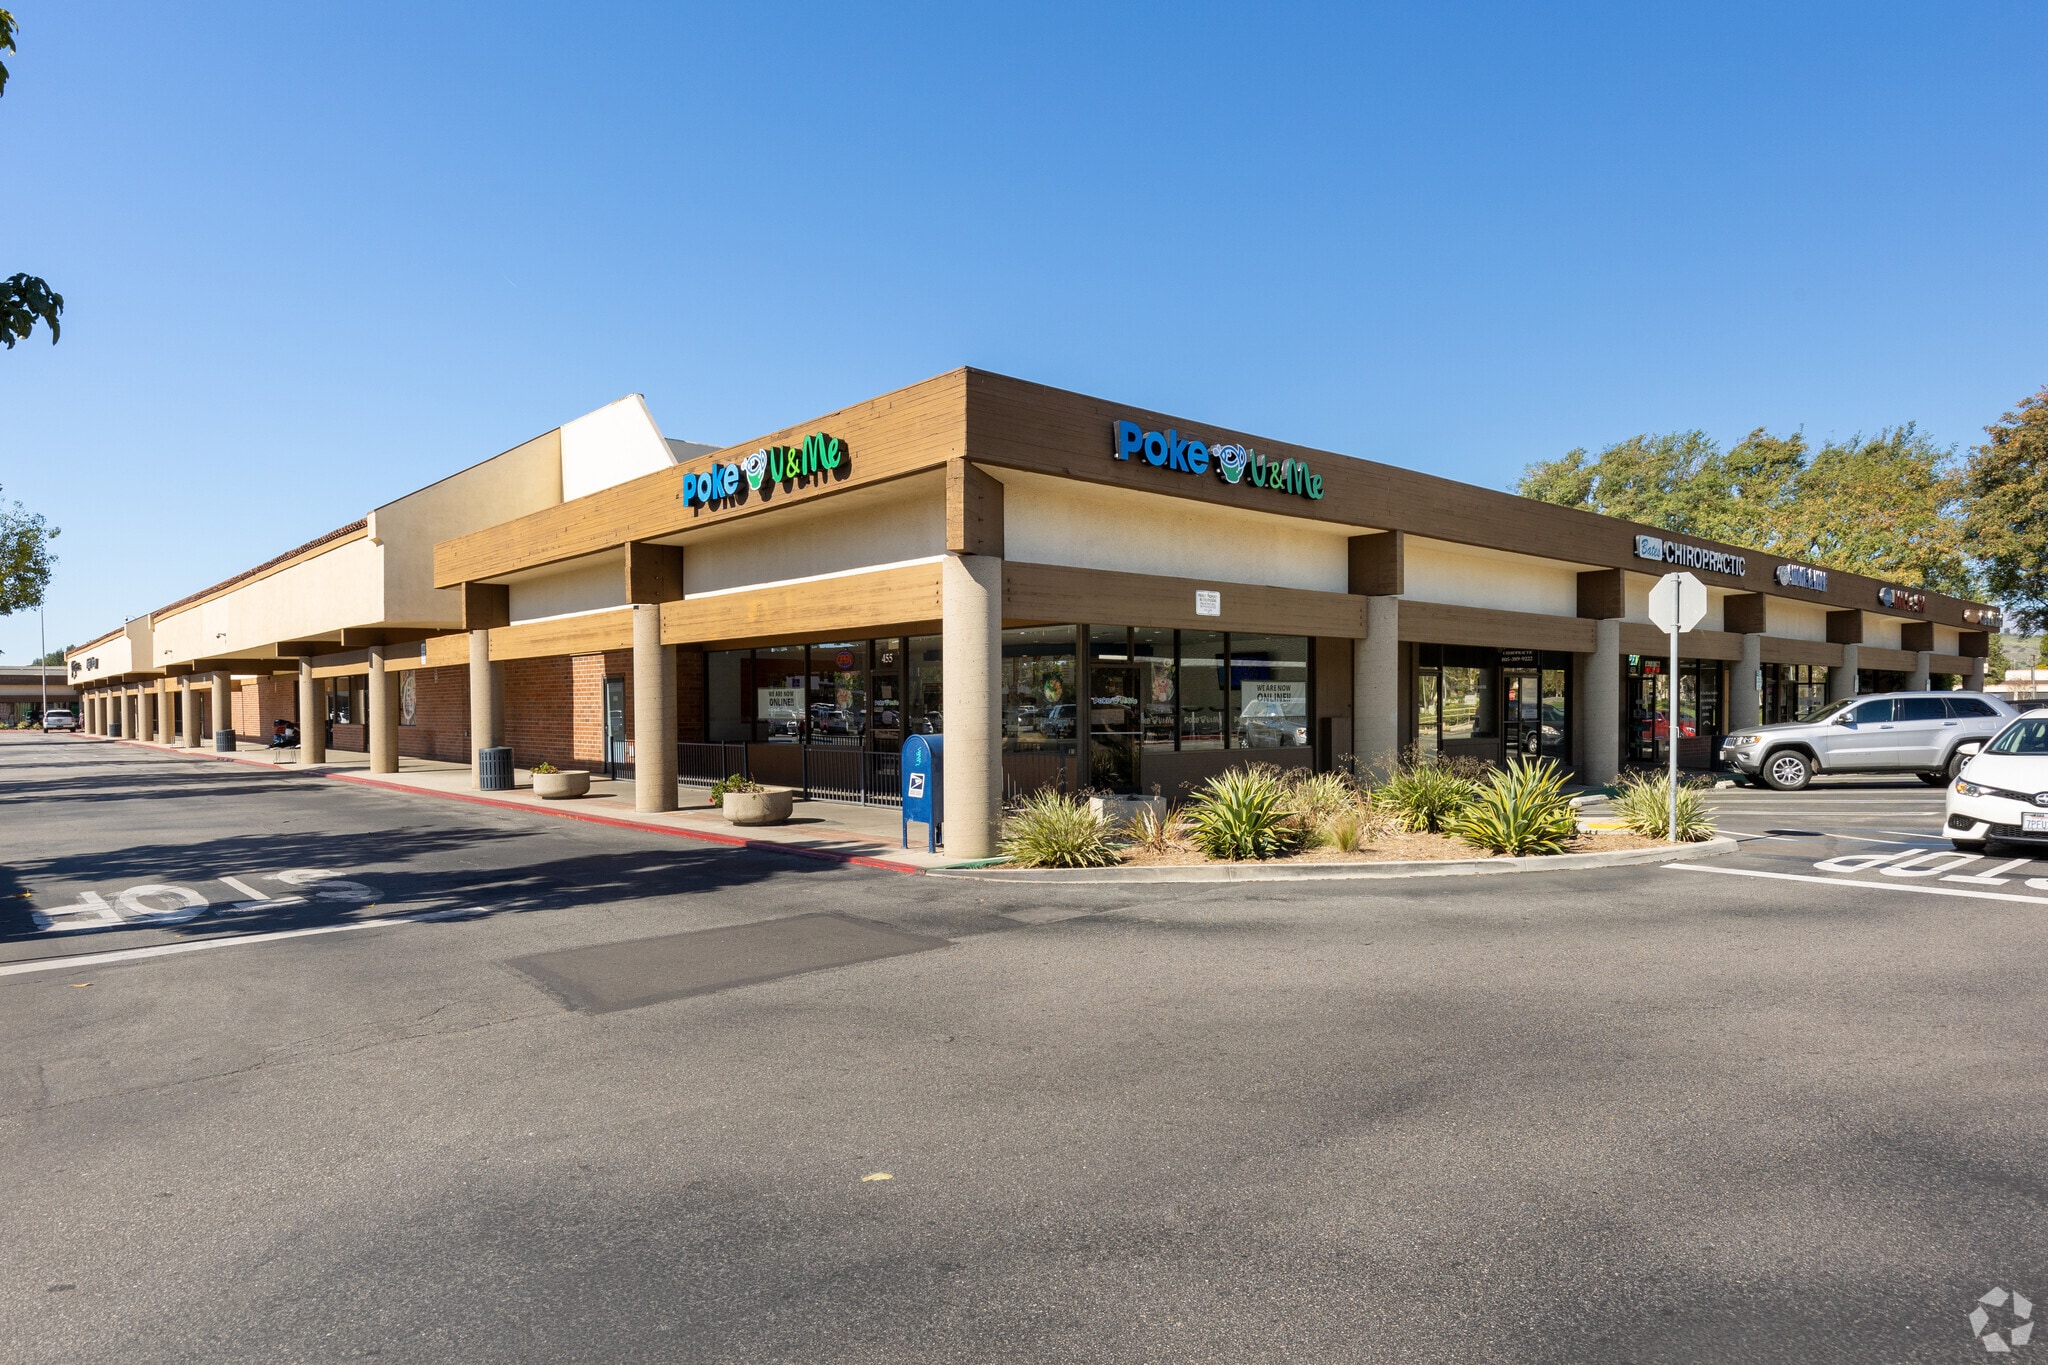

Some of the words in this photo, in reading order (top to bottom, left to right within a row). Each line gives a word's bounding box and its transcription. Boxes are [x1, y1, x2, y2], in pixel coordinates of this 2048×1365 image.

[1119, 420, 1209, 474] Poke
[683, 463, 739, 507] Poke
[1641, 538, 1661, 557] Bates
[1665, 541, 1745, 576] CHIROPRACTIC
[881, 653, 893, 663] 455
[1257, 684, 1265, 692] WE
[1266, 684, 1276, 692] ARE
[1278, 684, 1291, 692] NOW
[1257, 693, 1291, 702] ONLINE!!
[2026, 819, 2048, 830] 7PFU
